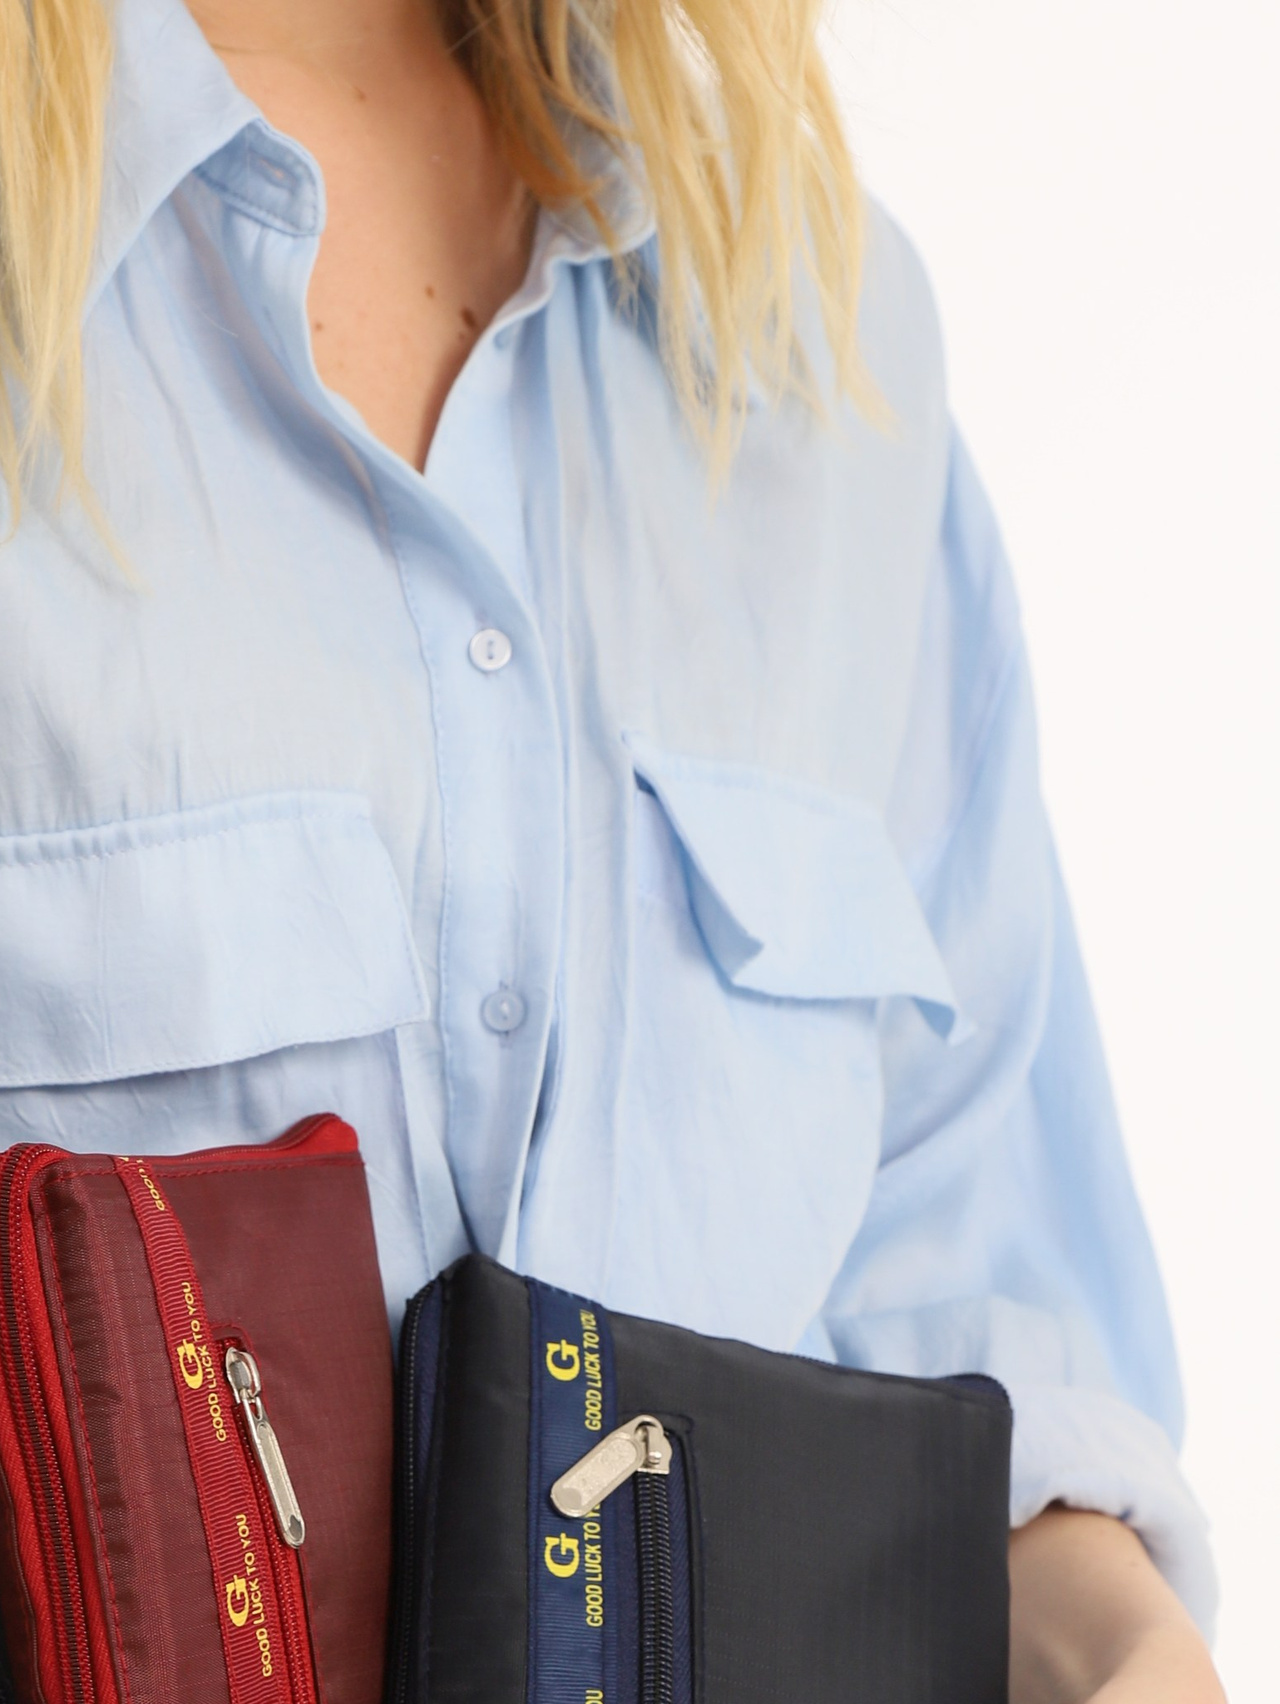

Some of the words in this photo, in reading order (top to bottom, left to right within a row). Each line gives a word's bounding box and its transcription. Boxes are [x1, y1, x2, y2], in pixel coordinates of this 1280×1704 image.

[181, 1282, 197, 1315] YOU
[190, 1320, 203, 1341] TO
[583, 1332, 599, 1349] TO
[176, 1338, 203, 1389] G
[197, 1344, 217, 1389] LUCK
[546, 1339, 580, 1381] G
[584, 1351, 602, 1388] LUCK
[207, 1393, 227, 1441] GOOD
[585, 1389, 602, 1431] GOOD
[235, 1514, 251, 1549] YOU
[583, 1522, 601, 1540] TO
[244, 1552, 257, 1575] TO
[545, 1532, 579, 1578] G
[584, 1544, 602, 1581] LUCK
[225, 1574, 249, 1627] G
[249, 1577, 265, 1624] LUCK
[585, 1584, 603, 1627] GOOD
[256, 1628, 272, 1677] GOOD
